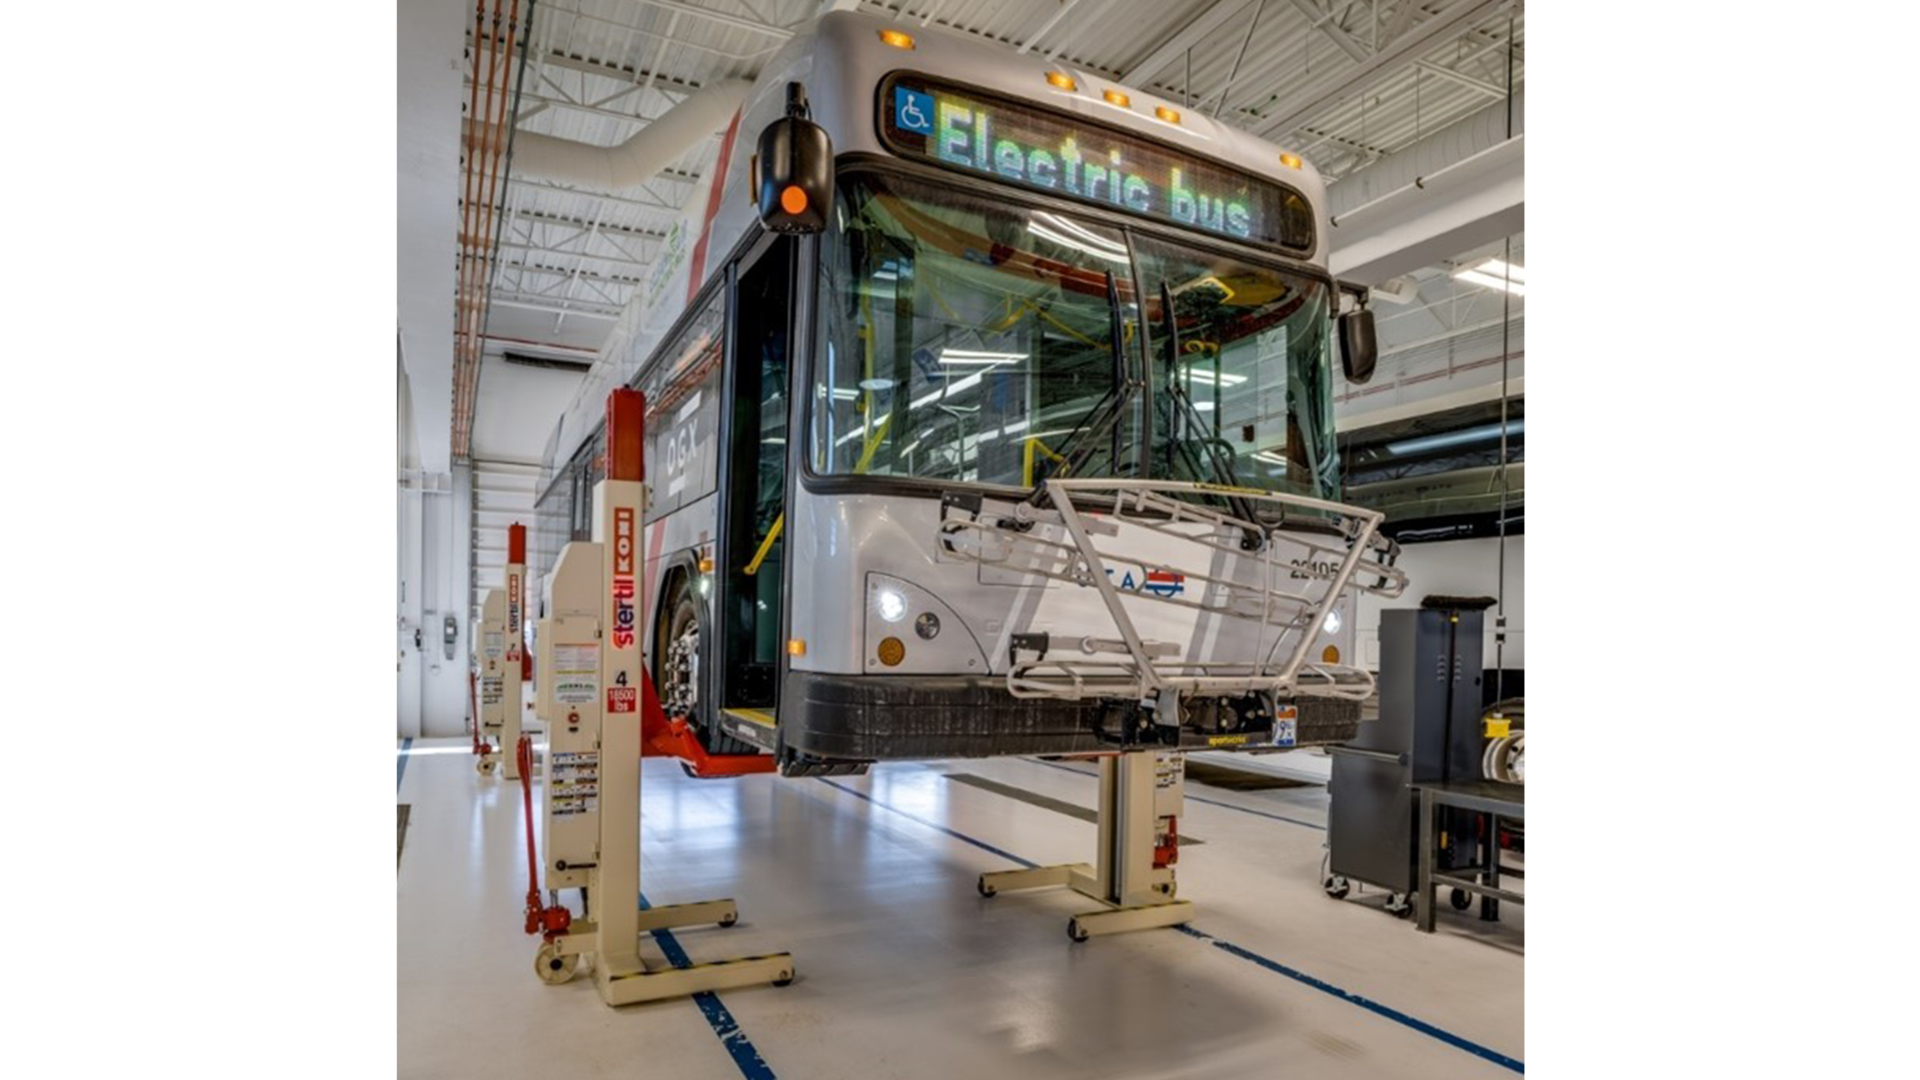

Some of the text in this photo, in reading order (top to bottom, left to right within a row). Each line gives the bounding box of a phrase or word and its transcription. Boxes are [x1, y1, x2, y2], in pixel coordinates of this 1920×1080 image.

[938, 101, 1251, 238] Electric bus
[666, 418, 698, 476] OGX
[613, 510, 634, 649] stertil KONI
[1290, 559, 1340, 580] 22105
[615, 671, 628, 686] 4
[614, 700, 629, 711] lbs
